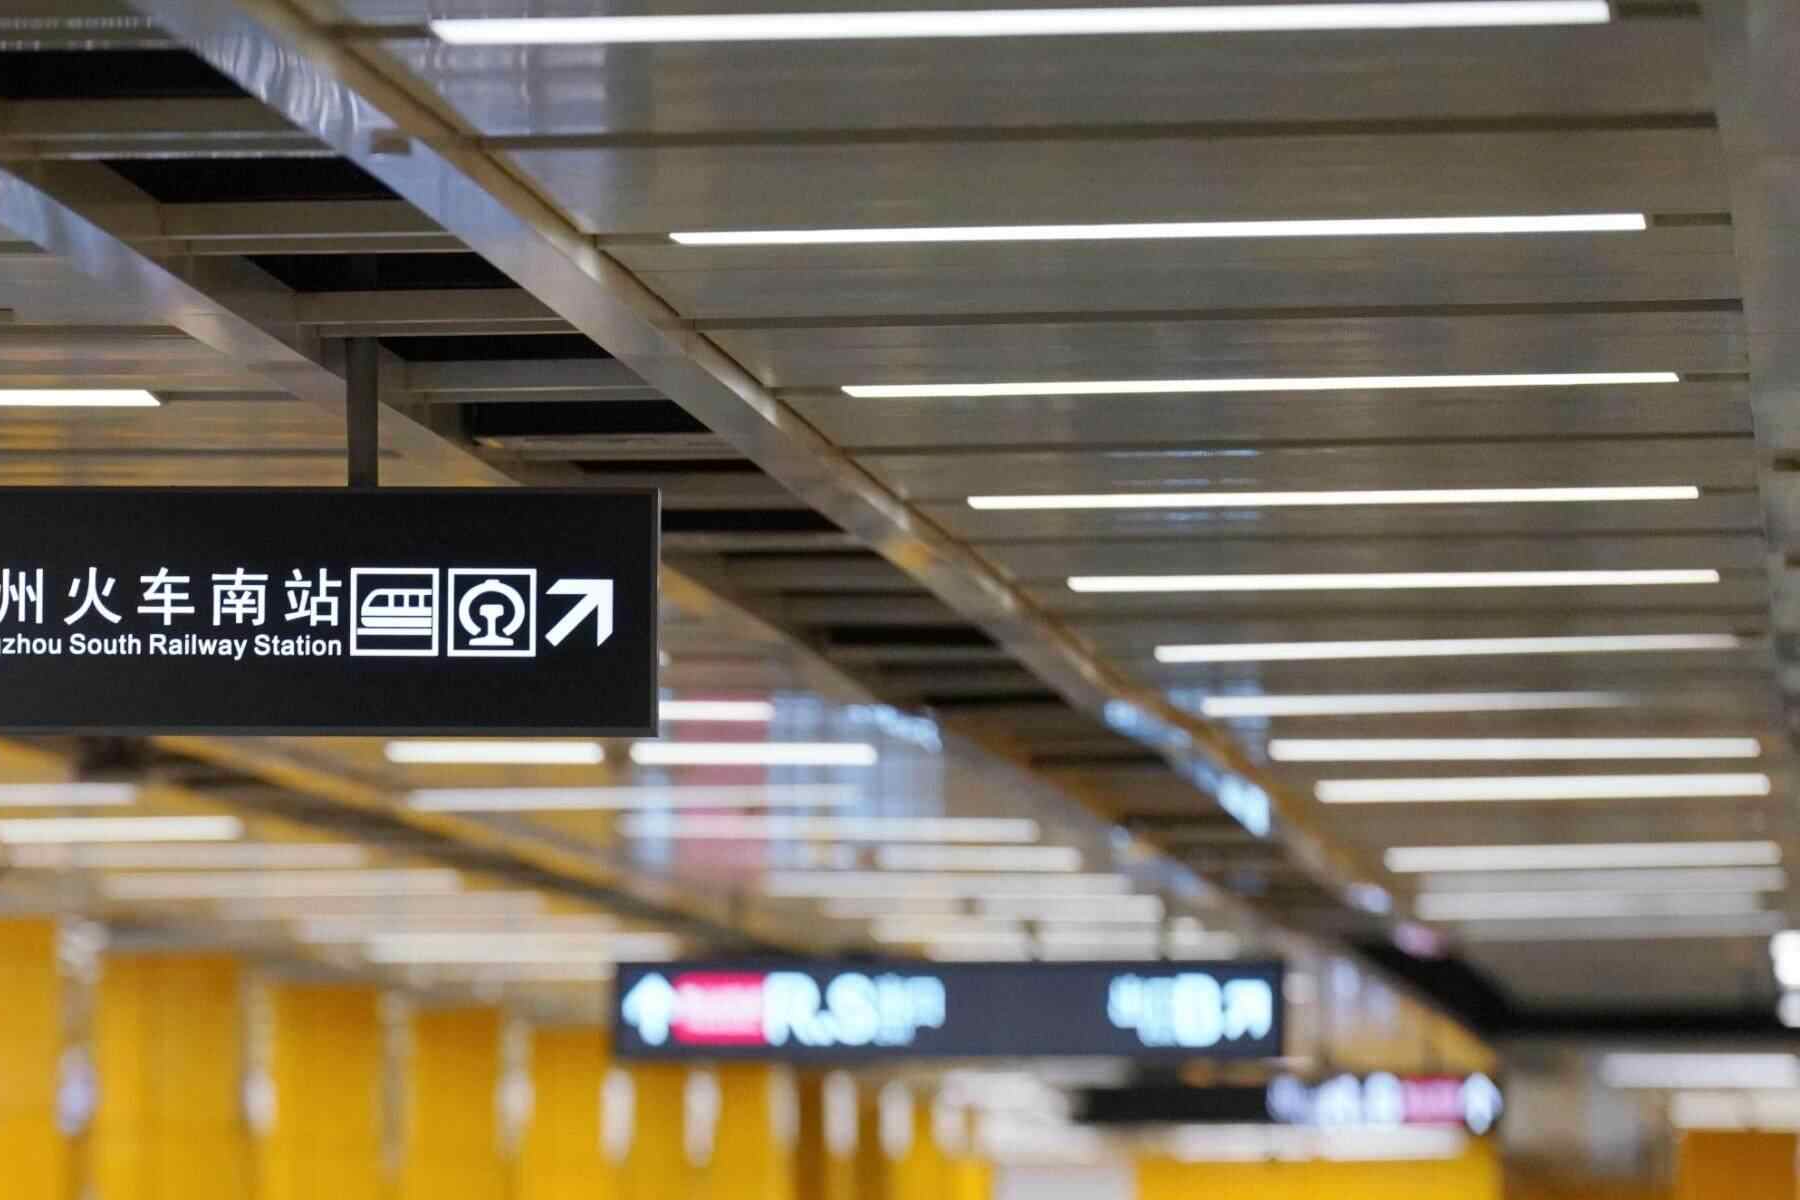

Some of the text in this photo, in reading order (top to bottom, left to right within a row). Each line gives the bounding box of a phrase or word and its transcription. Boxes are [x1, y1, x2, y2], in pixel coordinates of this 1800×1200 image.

[68, 632, 142, 656] South
[149, 633, 248, 661] Railway
[253, 633, 342, 657] Station
